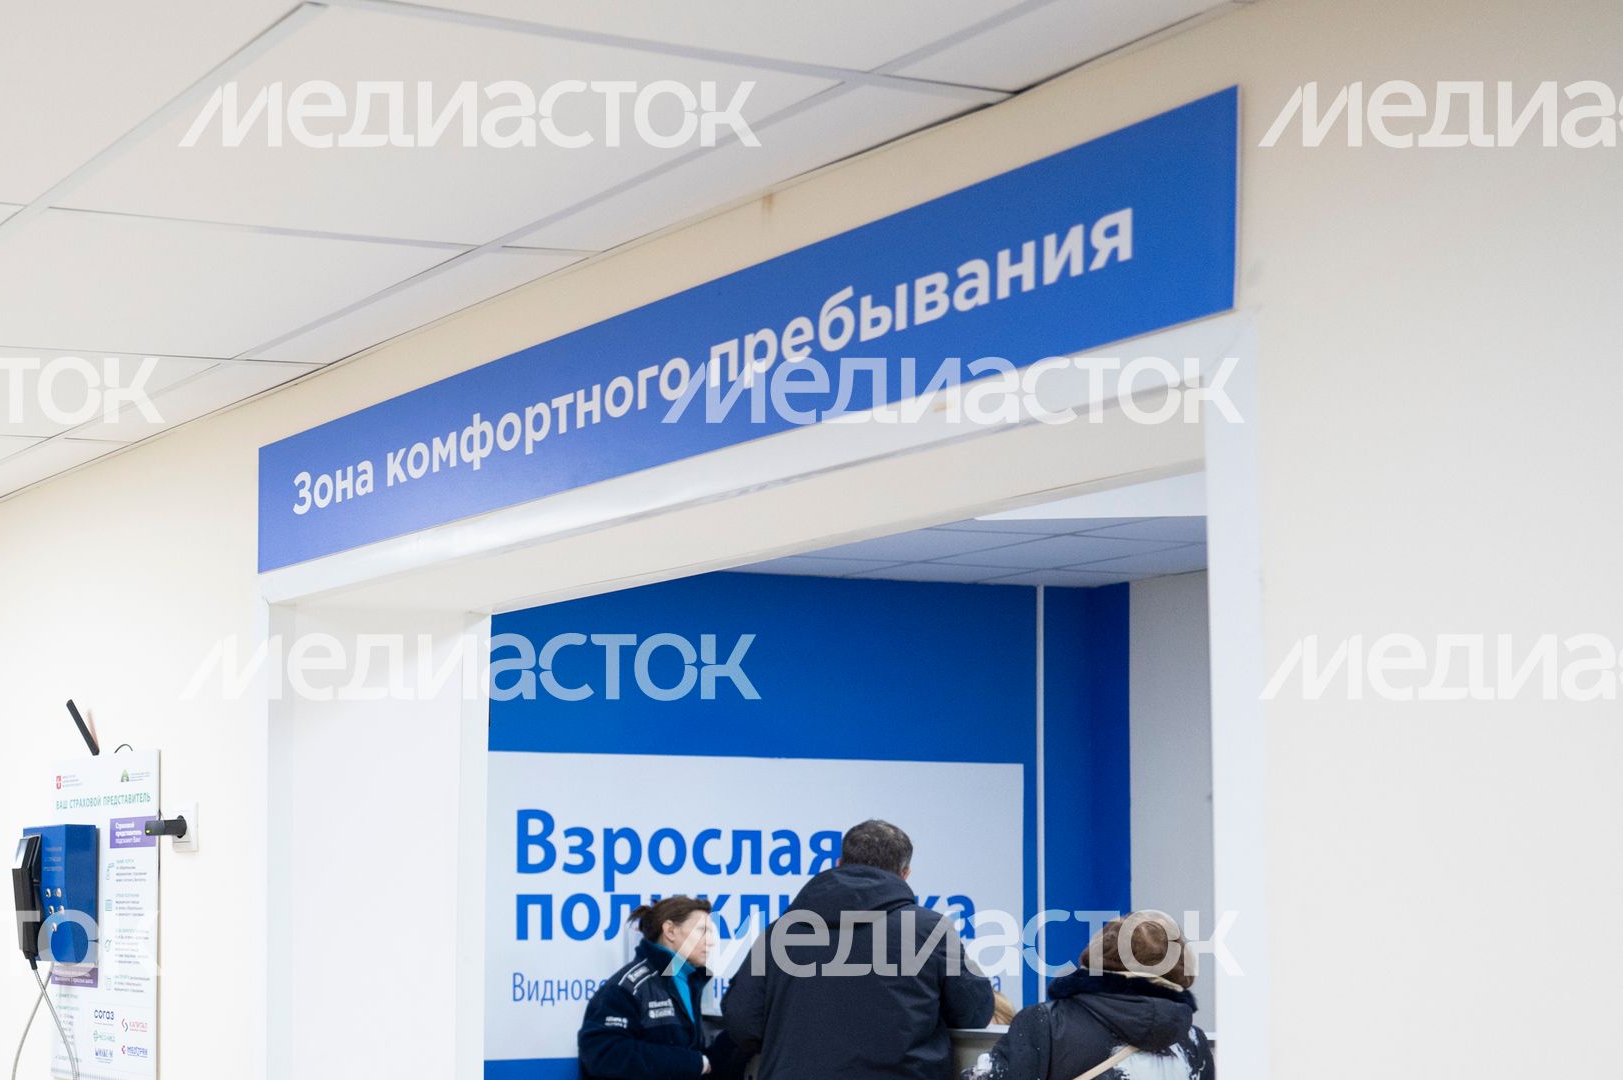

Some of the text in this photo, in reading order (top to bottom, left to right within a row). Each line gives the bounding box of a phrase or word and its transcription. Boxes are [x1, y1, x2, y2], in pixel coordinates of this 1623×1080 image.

[293, 207, 1134, 516] Зона комфортного пребывания
[56, 791, 151, 810] ВАШ СТРАХОВОЙ ПРЕДСТАВИТЕЛЬ
[516, 809, 843, 893] Взрослая
